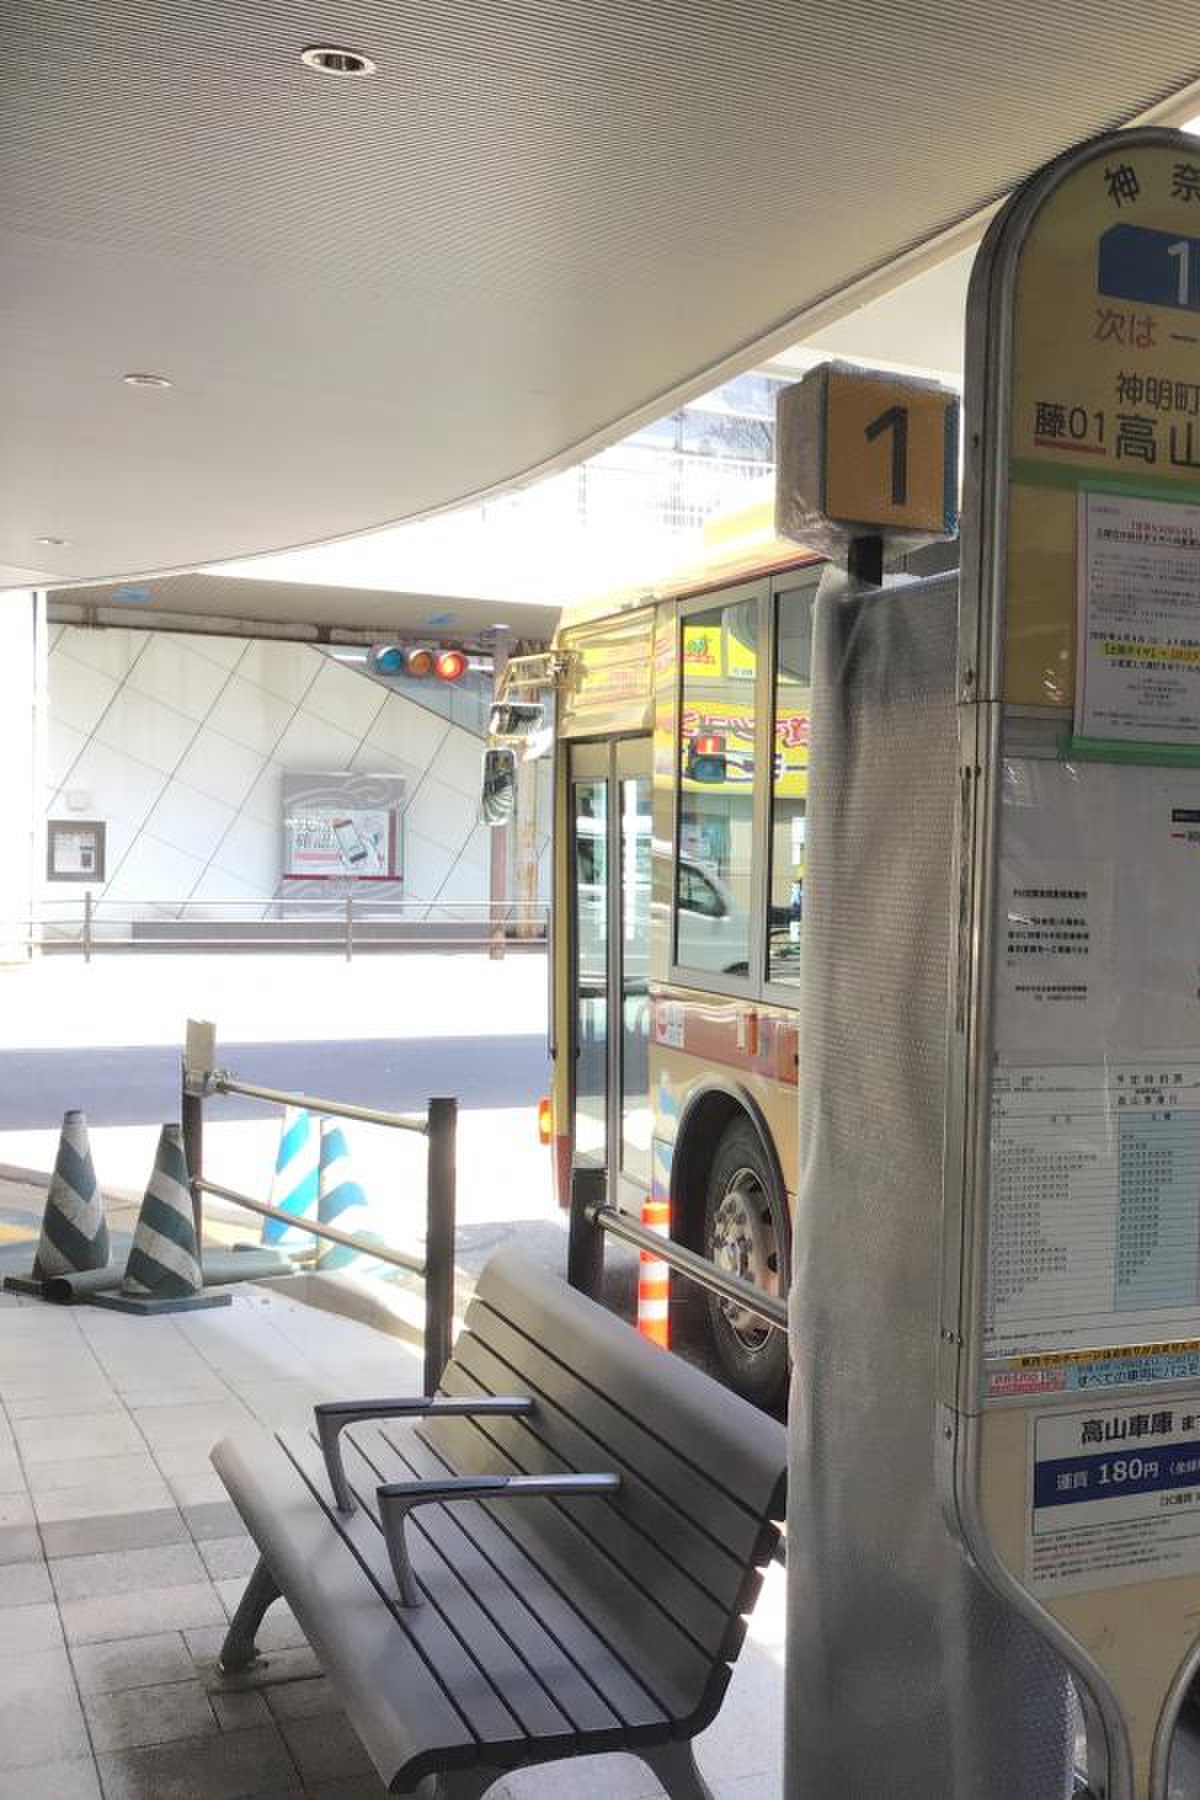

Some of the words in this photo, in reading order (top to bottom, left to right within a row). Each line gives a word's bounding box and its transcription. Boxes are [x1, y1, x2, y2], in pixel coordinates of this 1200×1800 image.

[1167, 241, 1190, 304] 1
[1092, 308, 1156, 348] 次は
[864, 405, 908, 506] 1
[1080, 1410, 1173, 1445] 高山車庫
[1098, 1457, 1160, 1485] 180円
